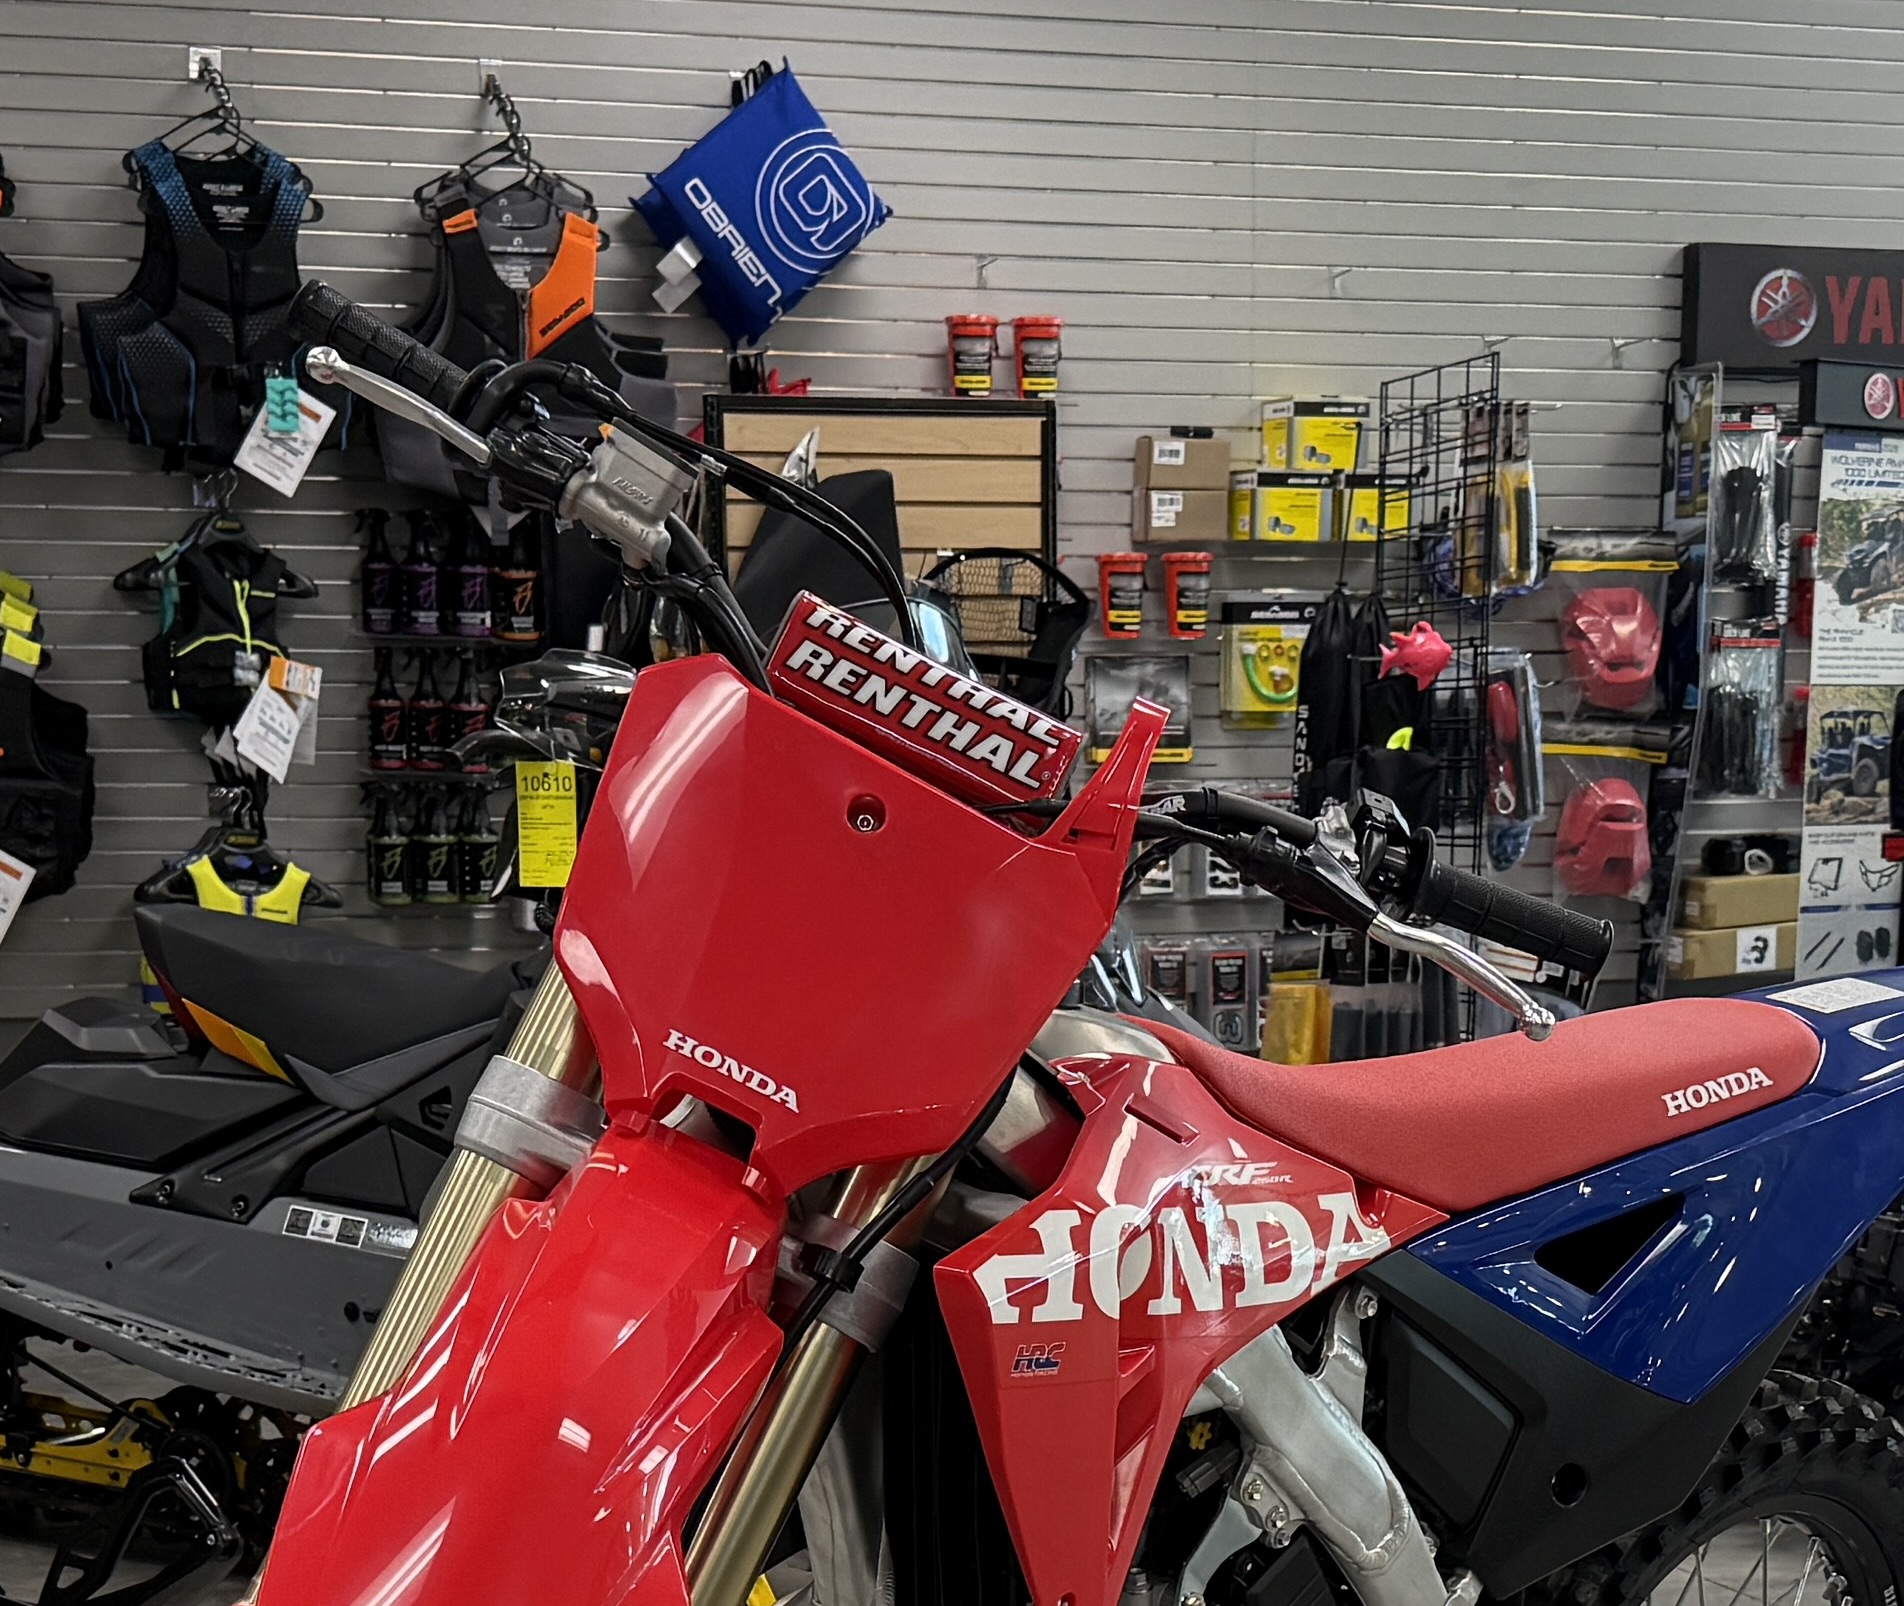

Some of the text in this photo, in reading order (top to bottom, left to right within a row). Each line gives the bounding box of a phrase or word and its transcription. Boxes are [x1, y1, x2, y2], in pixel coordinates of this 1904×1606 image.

[785, 639, 1042, 790] RENTHAL
[806, 604, 1060, 747] RENTHAL
[521, 775, 573, 792] 10610
[662, 1028, 800, 1114] HONDA
[1661, 1066, 1774, 1117] HONDA
[973, 1191, 1392, 1324] HONDA
[1011, 1341, 1066, 1372] HRC
